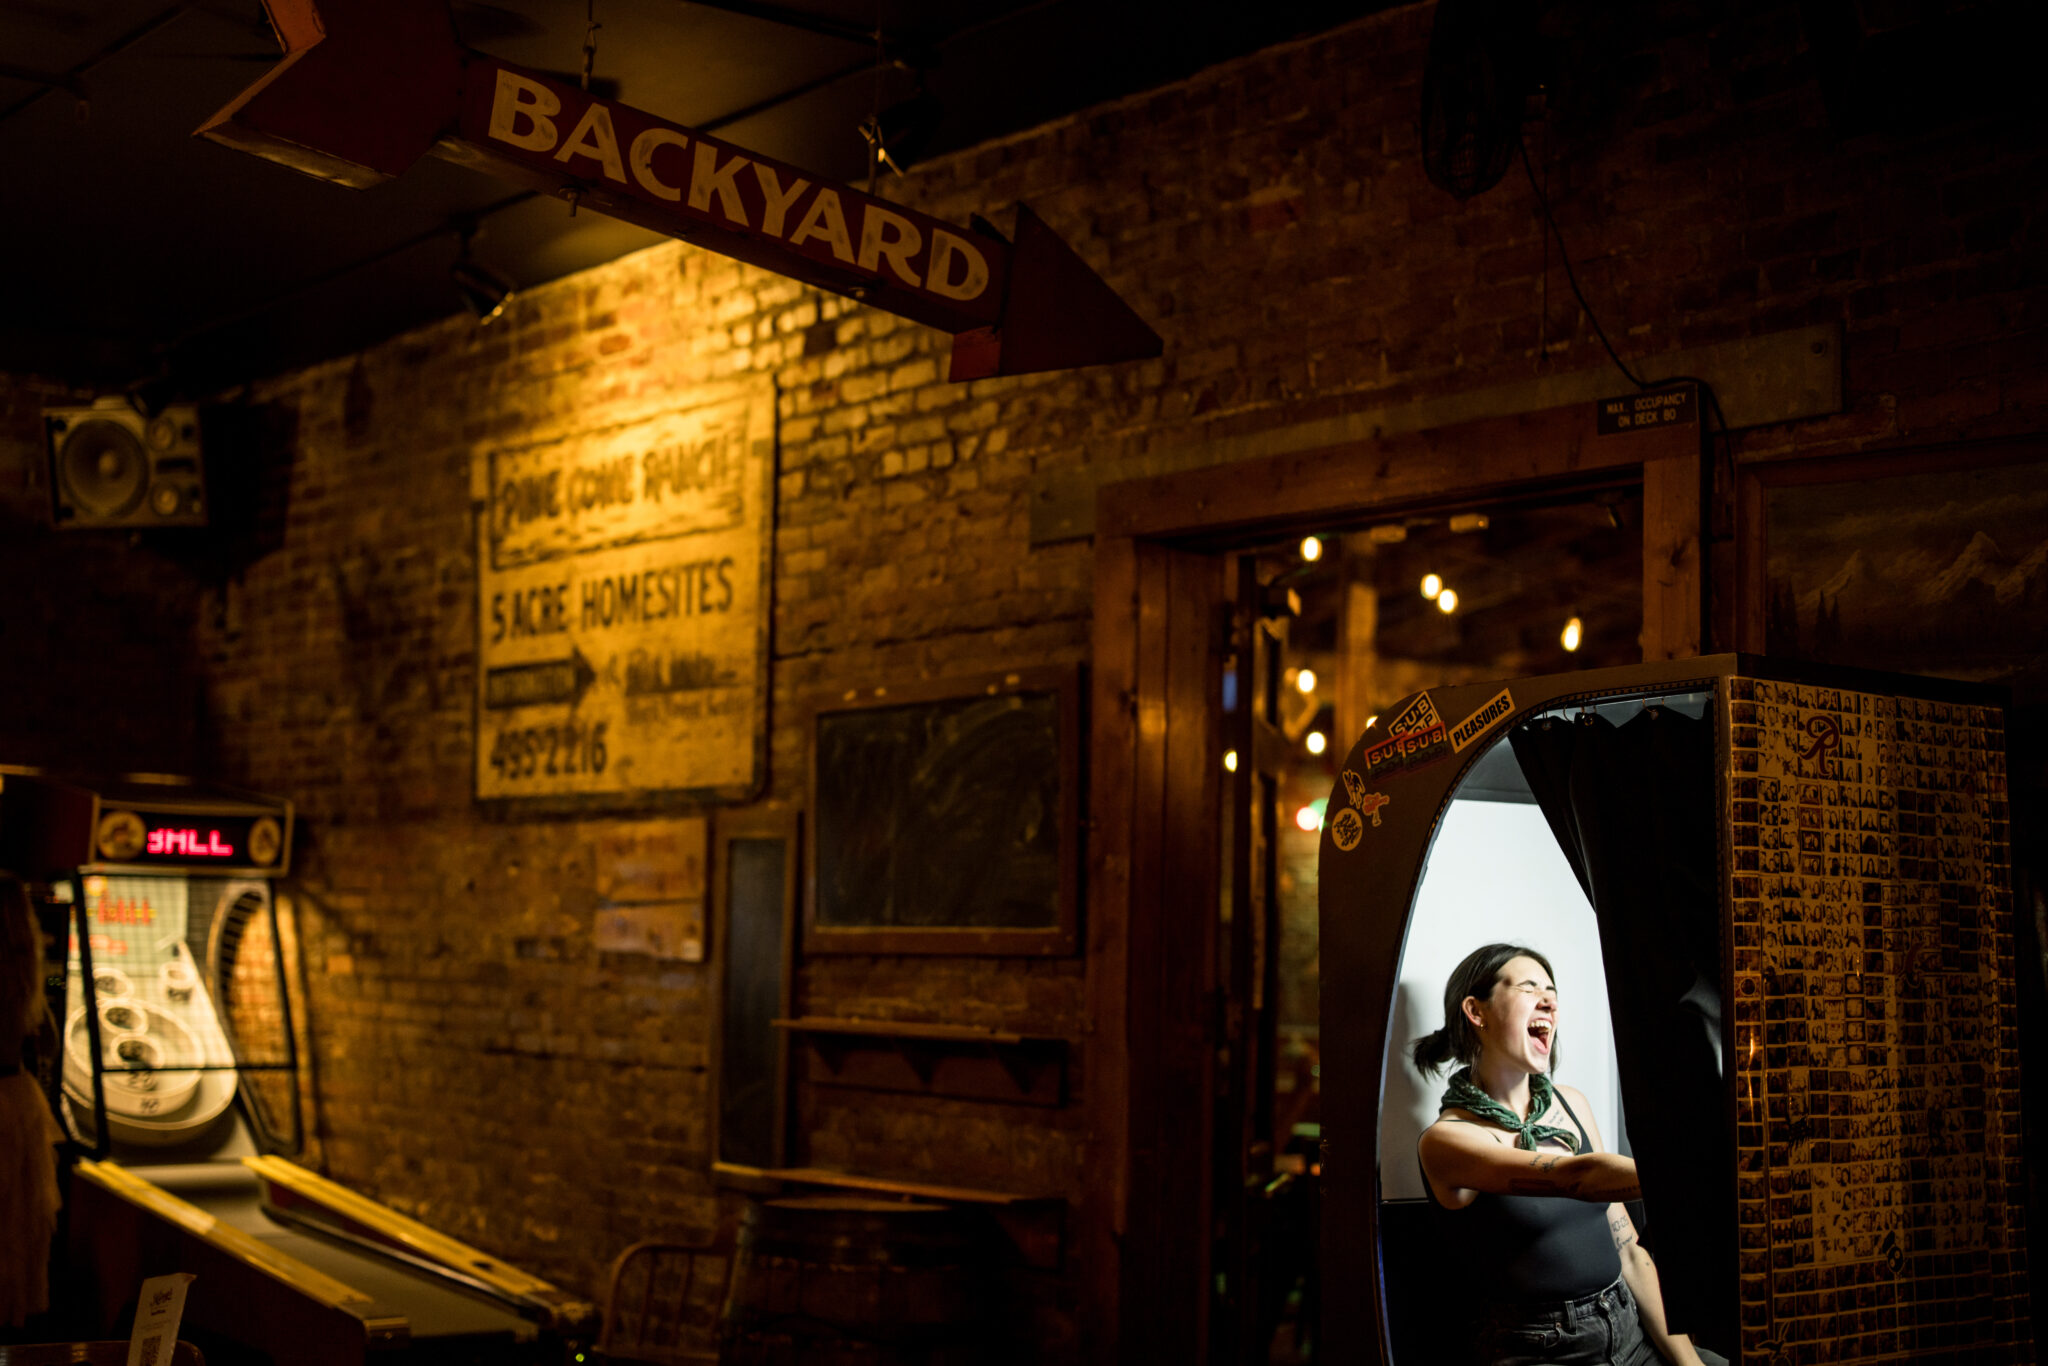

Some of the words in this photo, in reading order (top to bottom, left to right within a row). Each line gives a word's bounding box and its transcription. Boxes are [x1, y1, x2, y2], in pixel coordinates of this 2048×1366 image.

[488, 69, 989, 300] BACKYARD
[1618, 416, 1630, 428] ON
[1634, 412, 1658, 425] DECK
[1634, 392, 1687, 411] OCCUPANCY
[491, 593, 506, 643] 5
[510, 584, 569, 640] ACRE
[581, 557, 735, 633] HOMESITES
[1395, 698, 1430, 735] SUB
[1453, 694, 1511, 748] PLEASURES
[1407, 730, 1442, 754] SUB
